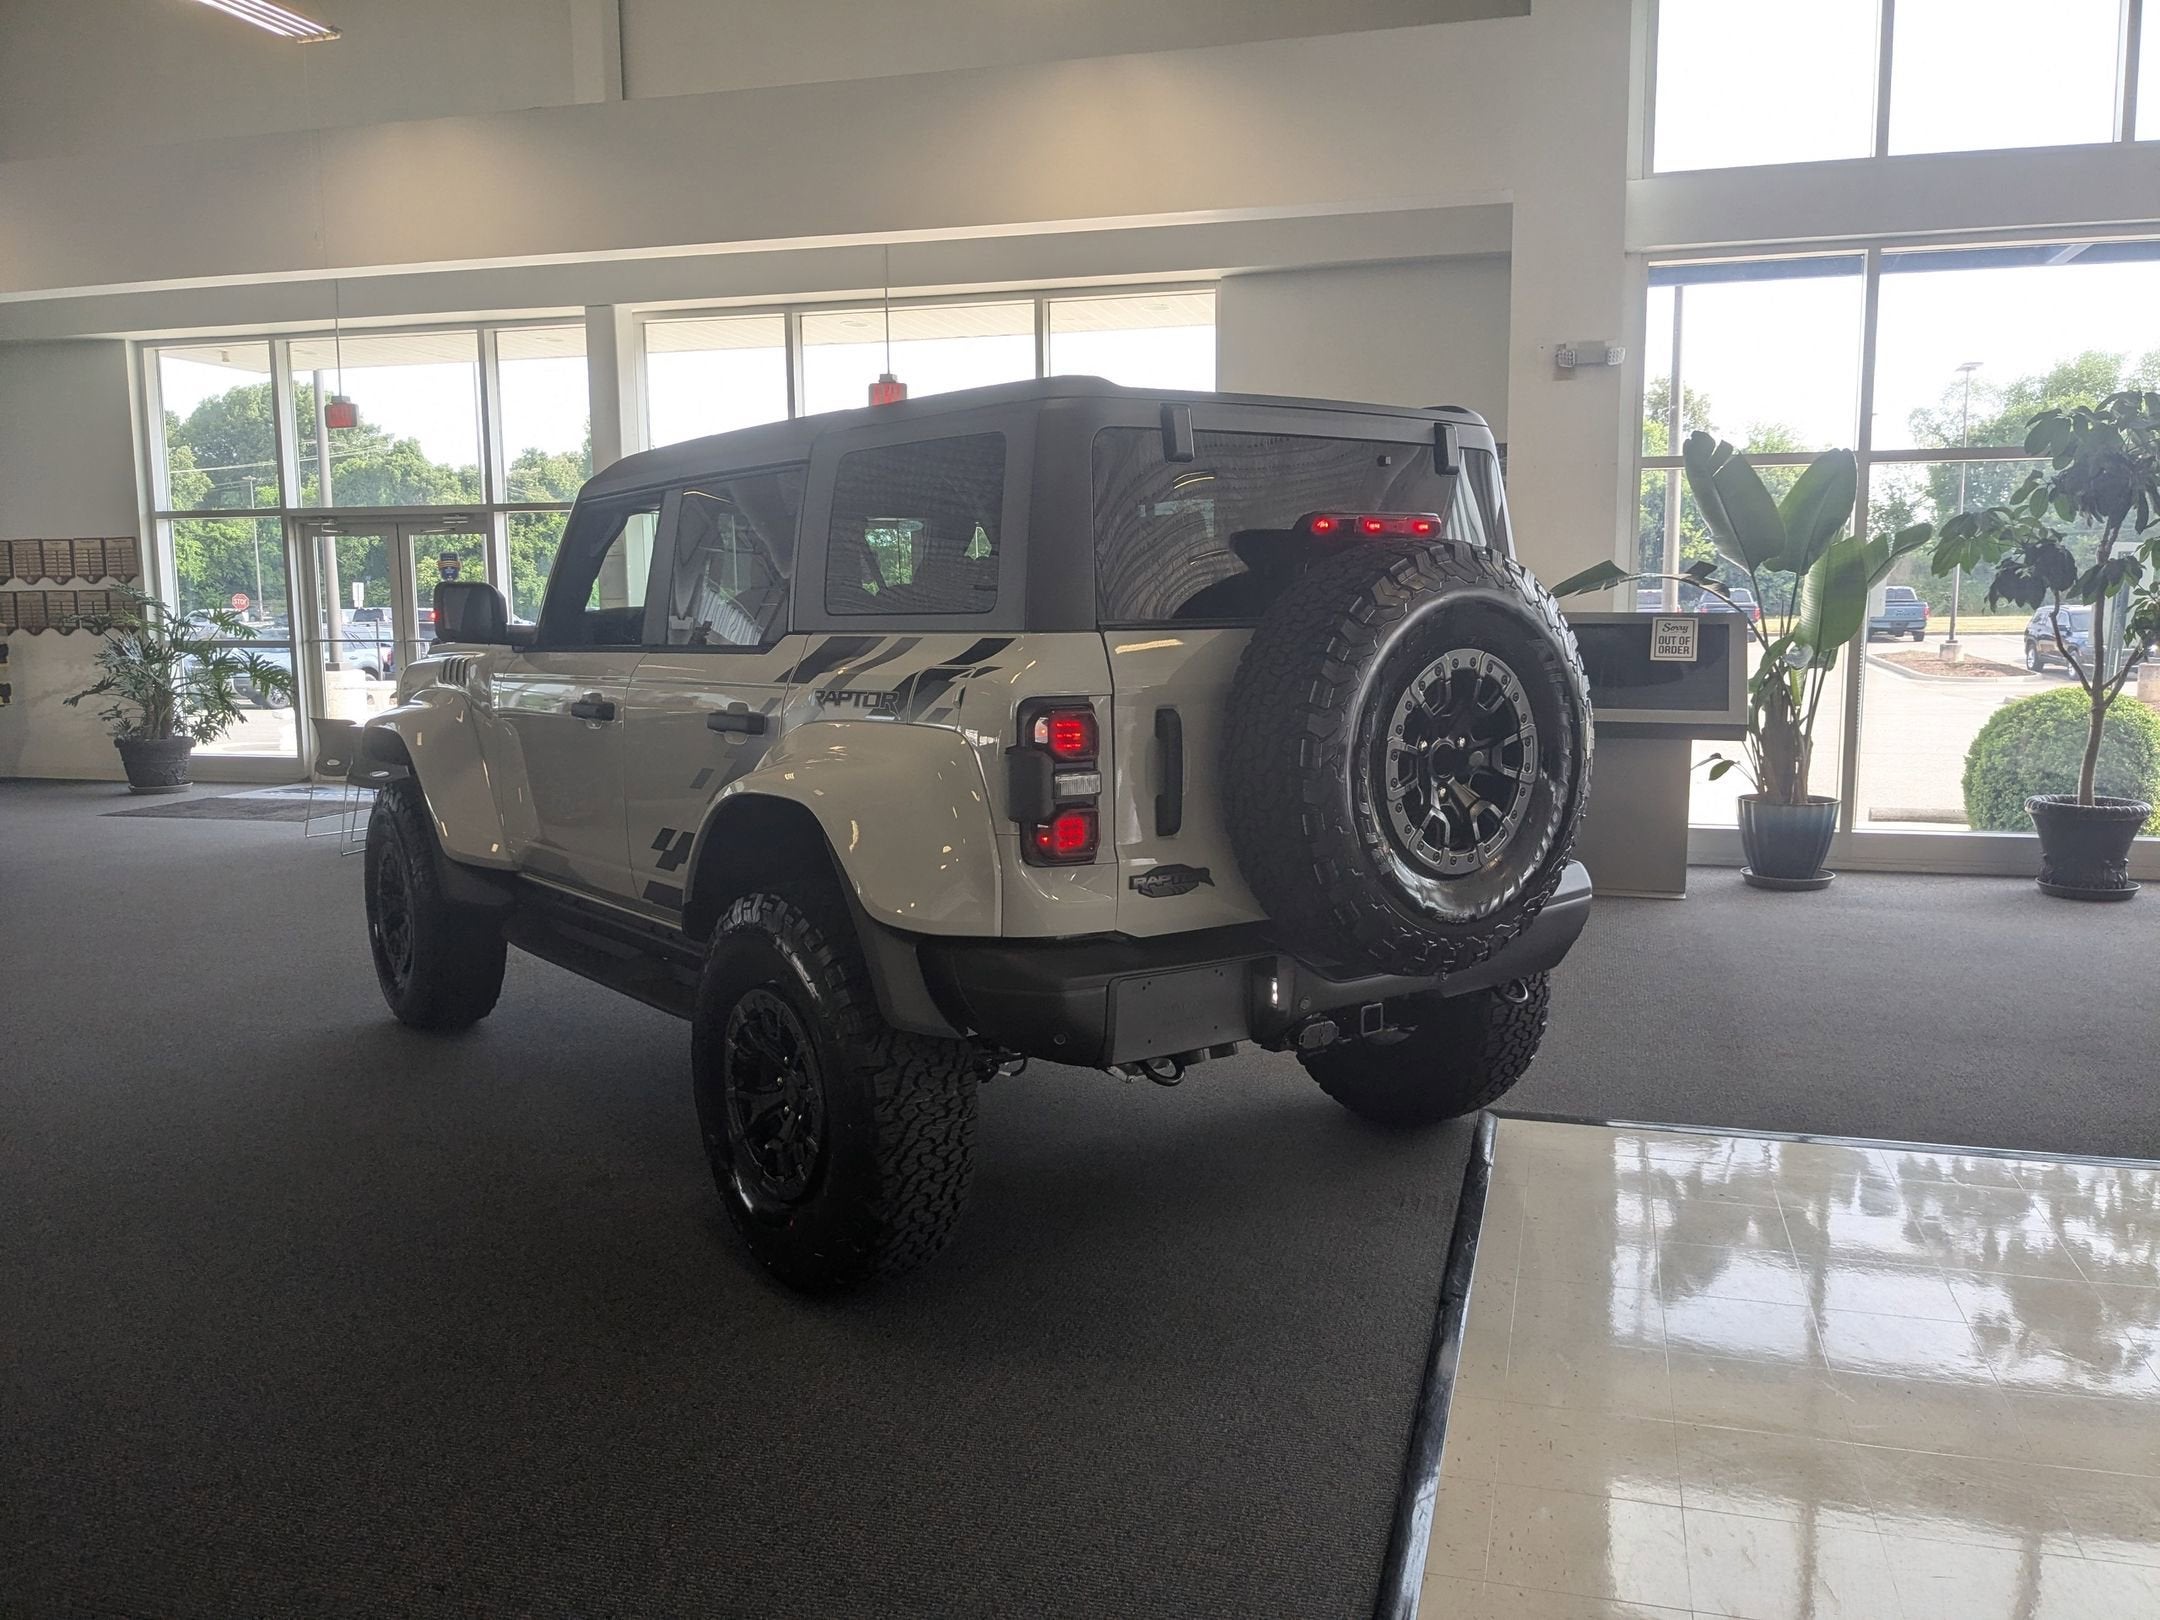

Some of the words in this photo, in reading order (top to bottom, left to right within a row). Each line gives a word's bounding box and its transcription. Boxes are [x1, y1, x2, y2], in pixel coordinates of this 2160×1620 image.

[1662, 622, 1689, 633] Sorry
[1658, 636, 1677, 645] OUT
[1679, 636, 1691, 646] OF
[1658, 645, 1690, 655] ORDER
[813, 689, 900, 720] RAPTOR
